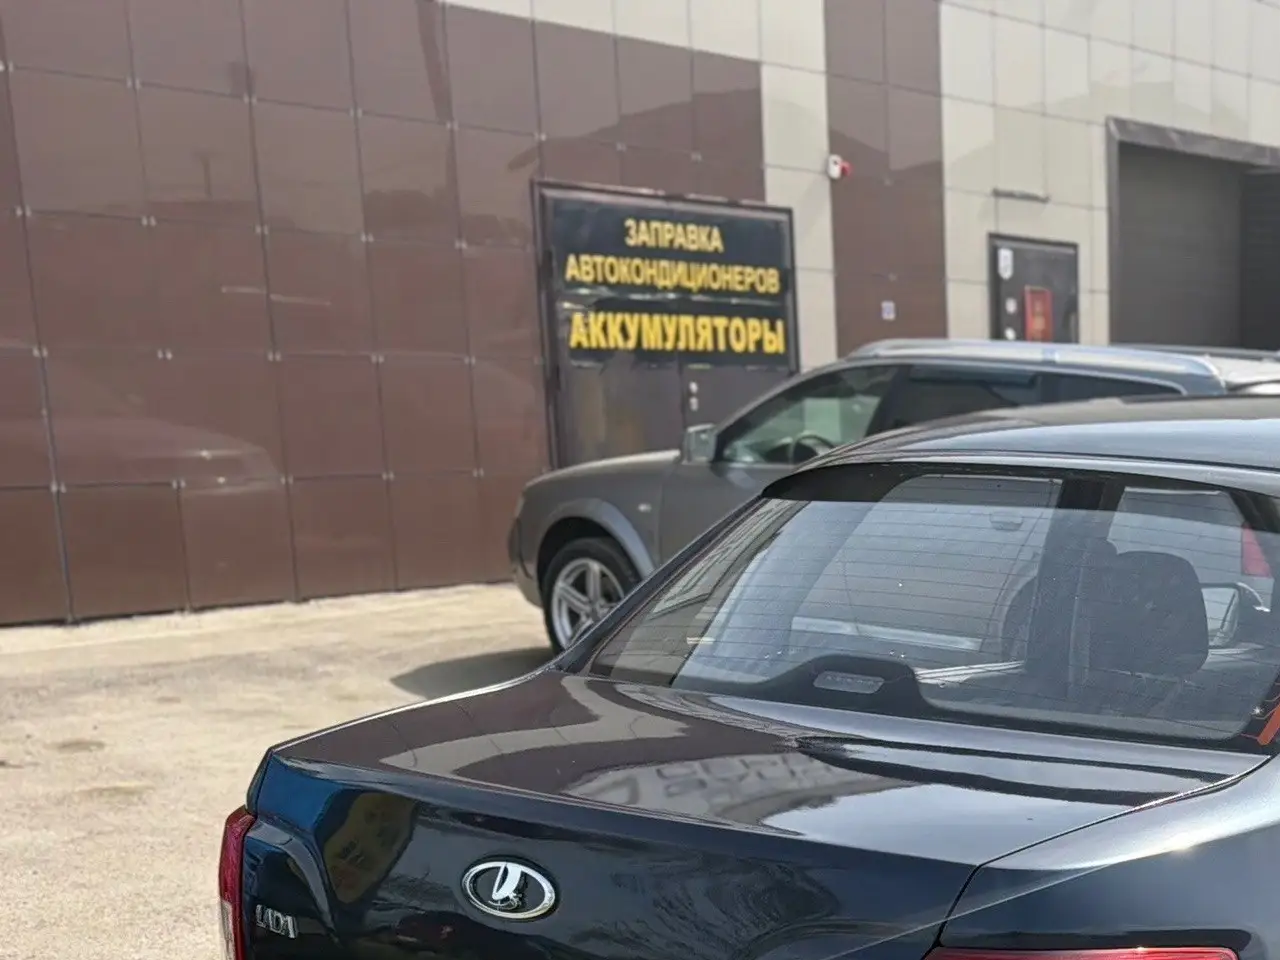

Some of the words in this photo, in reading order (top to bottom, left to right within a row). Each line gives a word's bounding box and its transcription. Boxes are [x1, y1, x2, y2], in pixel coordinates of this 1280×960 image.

[624, 218, 724, 253] ЗАПРАВКА
[565, 254, 781, 294] АВТОКОНДИЦИОНЕРОВ
[569, 312, 786, 354] АККУМУЛЯТОРЫ
[255, 904, 298, 939] LADA
